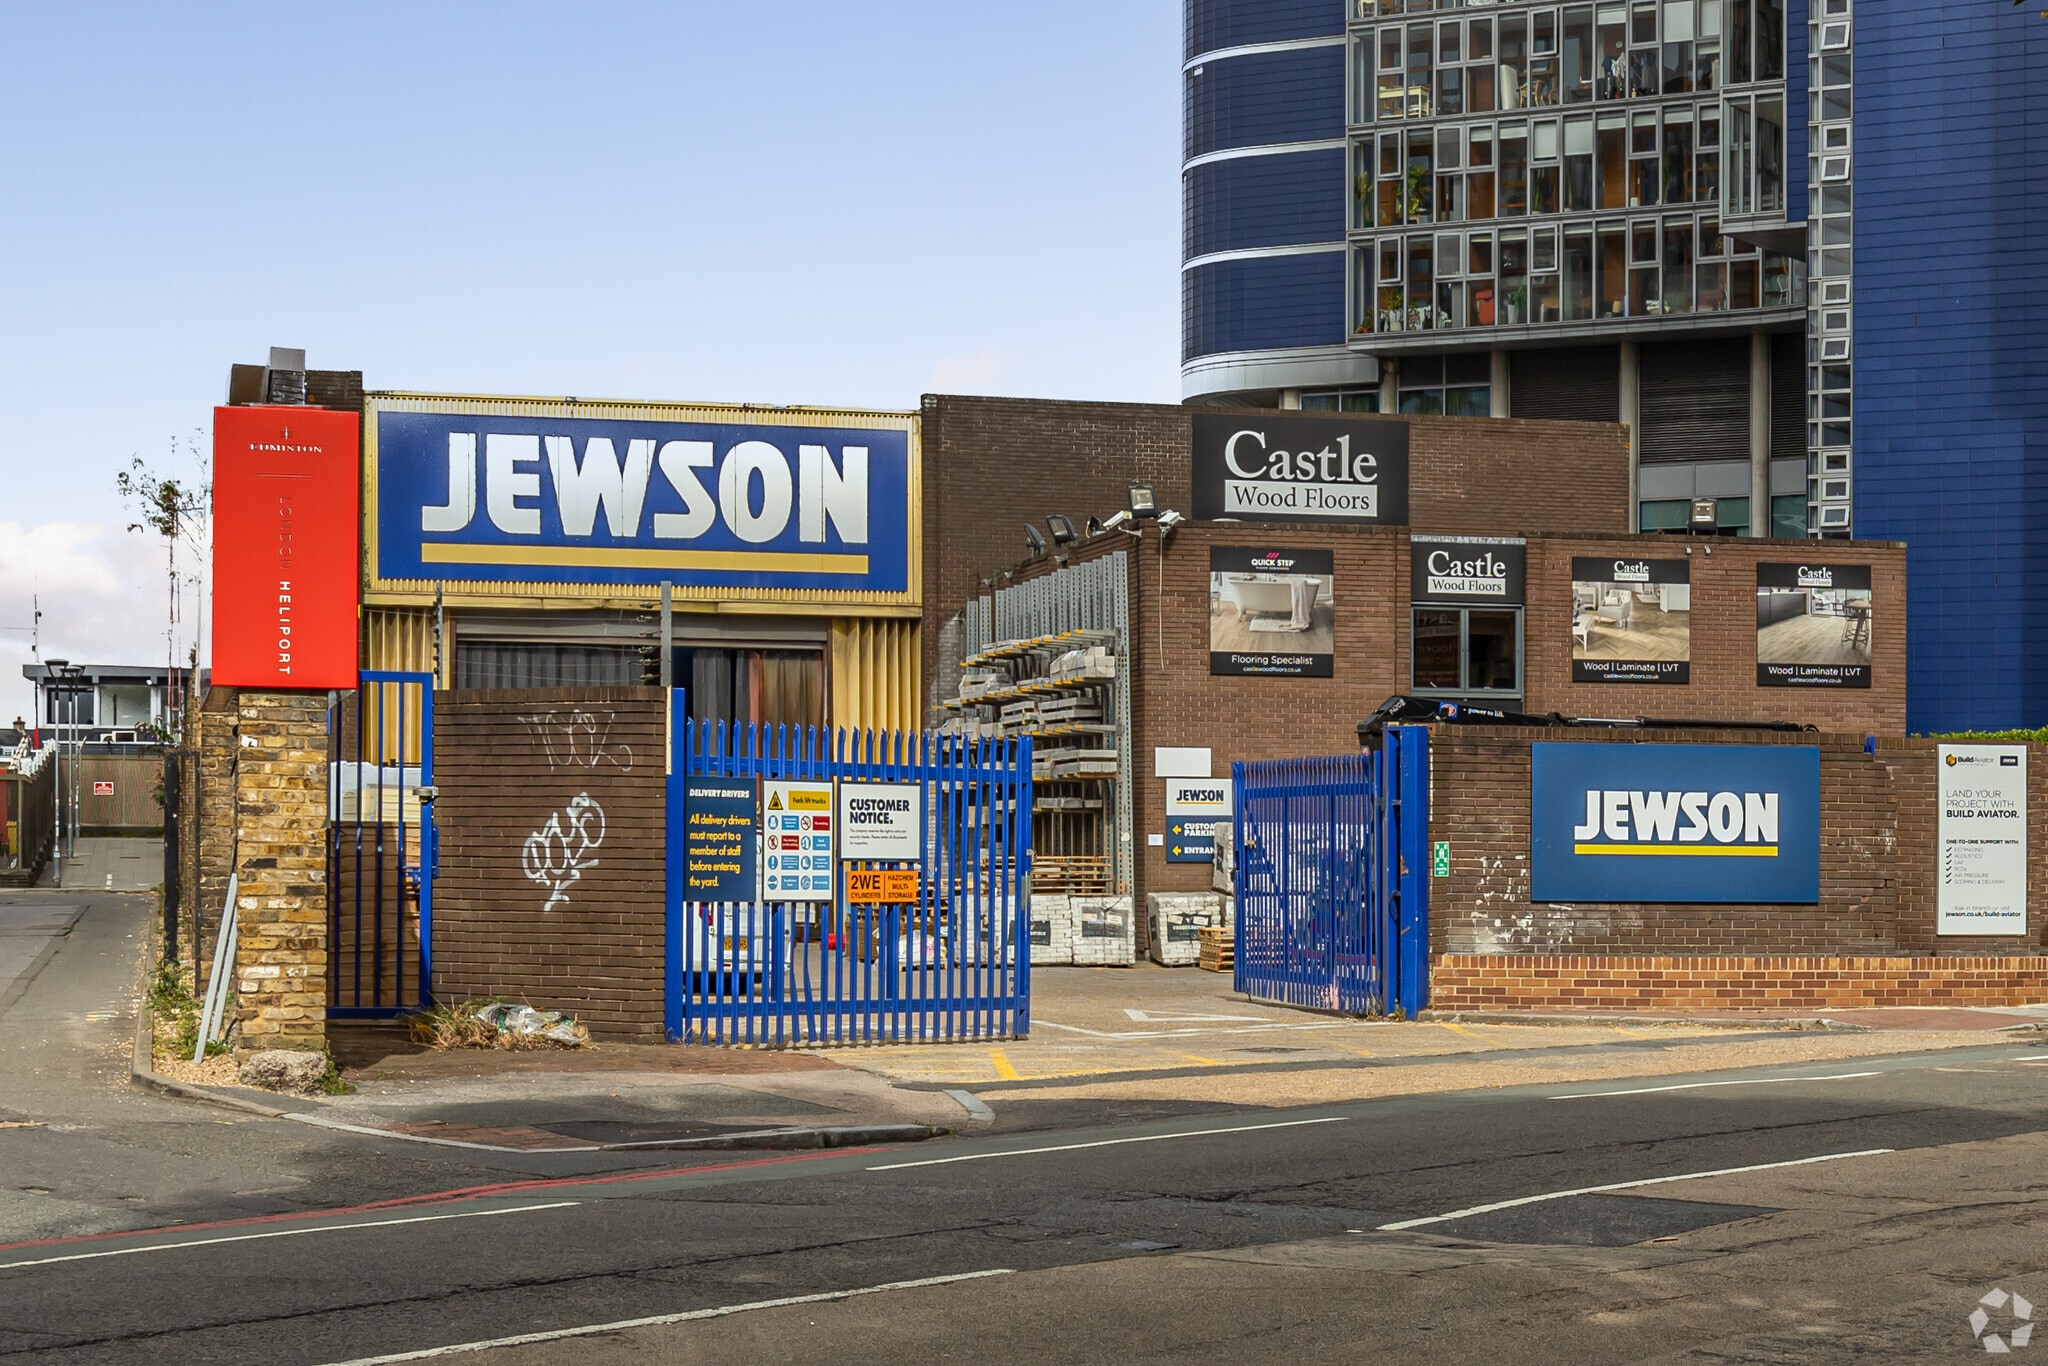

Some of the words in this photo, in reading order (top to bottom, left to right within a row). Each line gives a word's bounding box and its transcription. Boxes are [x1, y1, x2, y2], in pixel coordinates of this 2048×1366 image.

[1225, 430, 1378, 483] Castle
[421, 431, 869, 545] JEWSON
[1232, 485, 1297, 508] Wood
[1304, 487, 1370, 510] Floors
[1251, 558, 1275, 566] QUICK
[1276, 559, 1295, 567] STEP
[1427, 550, 1506, 578] Castle
[1614, 560, 1649, 574] Castle
[1798, 566, 1832, 579] Castle
[1432, 578, 1465, 591] Wood
[1468, 580, 1502, 592] Floors
[278, 581, 291, 675] HELIPORT
[1231, 654, 1269, 666] Flooring
[1271, 655, 1313, 665] Specialist
[1583, 662, 1609, 671] Wood
[1616, 662, 1656, 672] Laminate
[1662, 663, 1679, 672] LVT
[1768, 666, 1794, 675] Wood
[1800, 667, 1839, 676] Laminate
[1845, 667, 1861, 676] LVT
[689, 788, 721, 798] DELIVERY
[721, 789, 750, 798] DRIVERS
[1176, 789, 1224, 802] JEWSON
[1946, 790, 1973, 798] LAND
[1975, 790, 2001, 798] YOUR
[849, 798, 910, 811] CUSTOMER
[1946, 800, 1987, 808] PROJECT
[1990, 800, 2014, 808] WITH
[849, 812, 893, 824] NOTICE.
[1574, 790, 1779, 843] JEWSON
[1946, 810, 1974, 818] BUILD
[1977, 810, 2020, 818] AVIATOR.
[689, 813, 700, 824] All
[700, 814, 727, 828] delivery
[728, 814, 751, 825] drivers
[1184, 822, 1216, 830] CUSTOM
[689, 832, 706, 840] must
[706, 832, 728, 843] report
[728, 832, 735, 841] to
[735, 833, 741, 841] a
[689, 844, 718, 855] member
[718, 844, 727, 856] of
[727, 844, 742, 856] staff
[1184, 846, 1215, 854] ENTRAN
[689, 860, 712, 871] before
[713, 861, 740, 875] entering
[689, 875, 700, 887] the
[700, 875, 720, 890] yard.
[850, 874, 880, 890] 2WE
[887, 874, 914, 882] HAZCHEM
[850, 891, 881, 899] CYLINDERS
